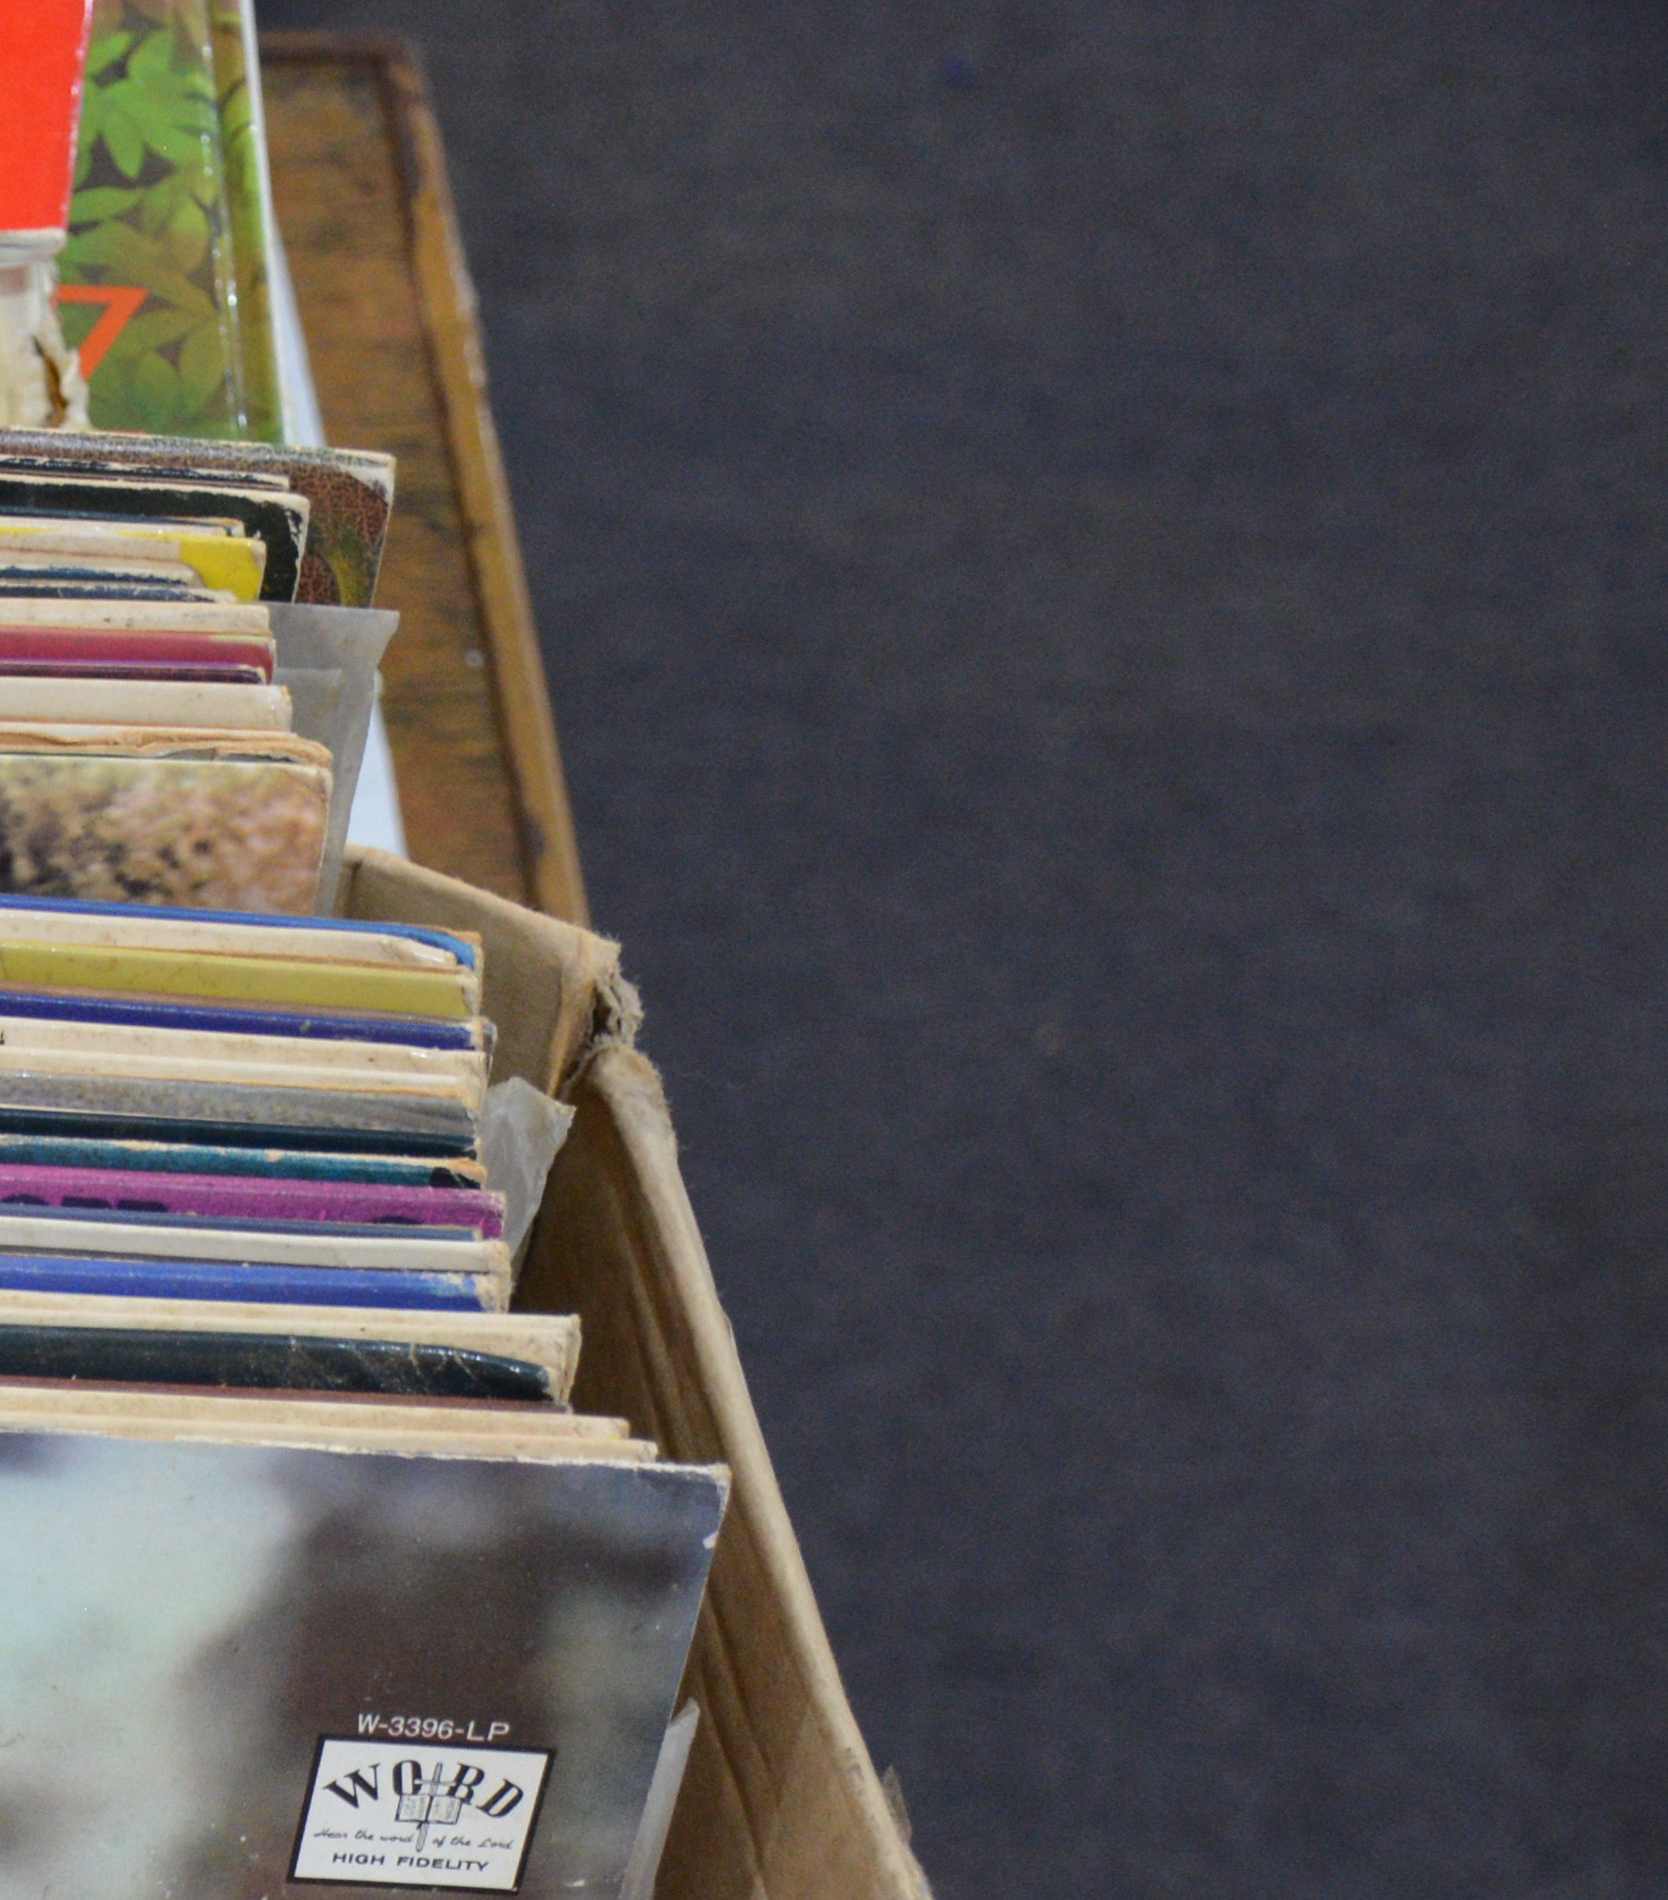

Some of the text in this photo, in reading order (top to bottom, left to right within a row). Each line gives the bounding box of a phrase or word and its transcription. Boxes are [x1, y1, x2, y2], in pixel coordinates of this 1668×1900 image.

[357, 1713, 511, 1742] W-3396-LP
[322, 1759, 524, 1818] WORD
[313, 1828, 515, 1850] Hear the word of the Lord
[332, 1853, 490, 1872] HIGH FIDELITY
